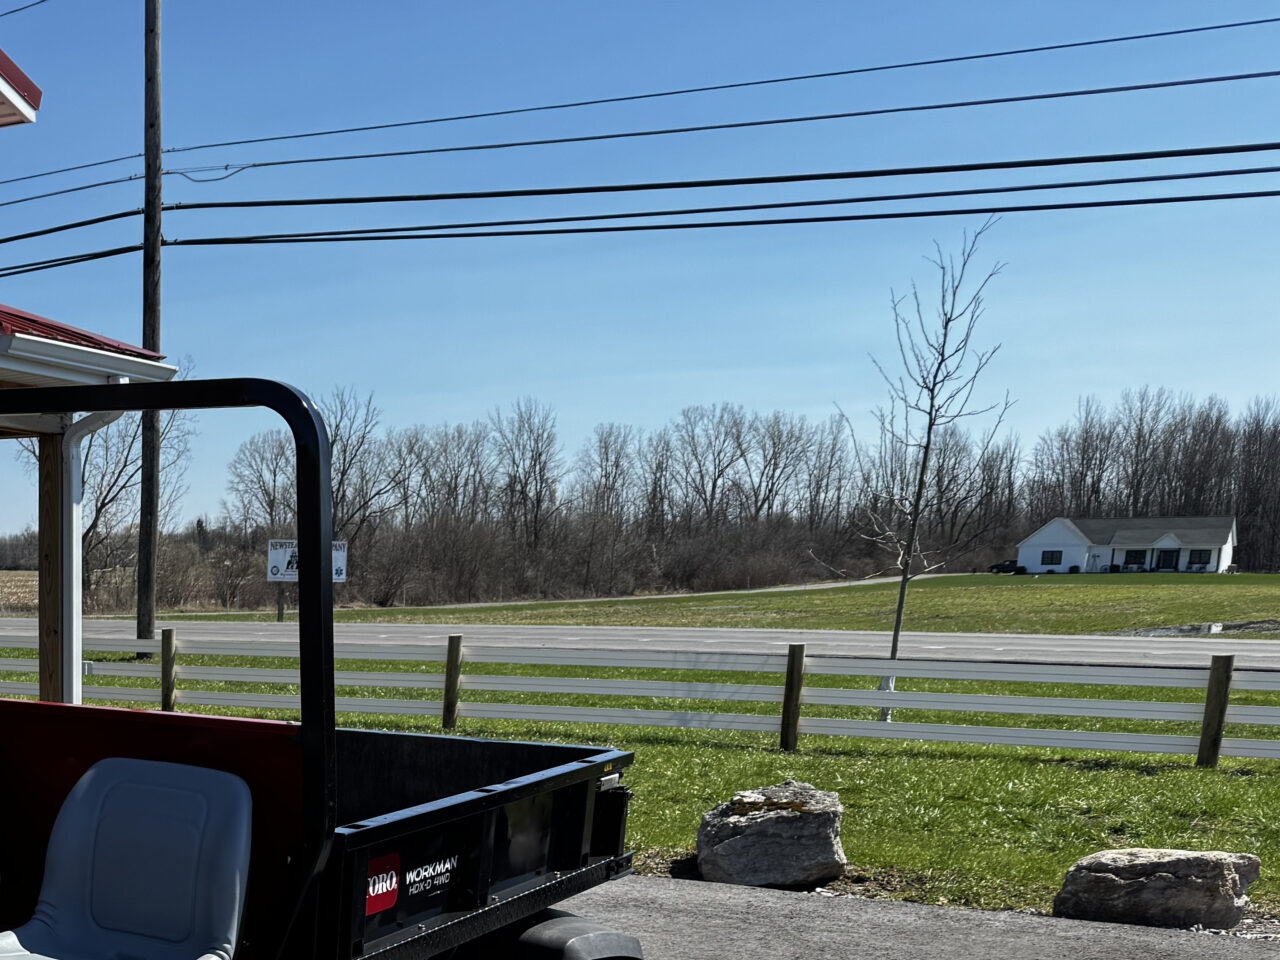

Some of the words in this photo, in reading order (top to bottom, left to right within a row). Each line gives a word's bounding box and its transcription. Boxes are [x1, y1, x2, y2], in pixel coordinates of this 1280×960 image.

[367, 870, 397, 897] ORO
[405, 855, 459, 885] WORKMAN
[408, 879, 432, 896] HDX-D
[433, 872, 451, 887] 4WD
